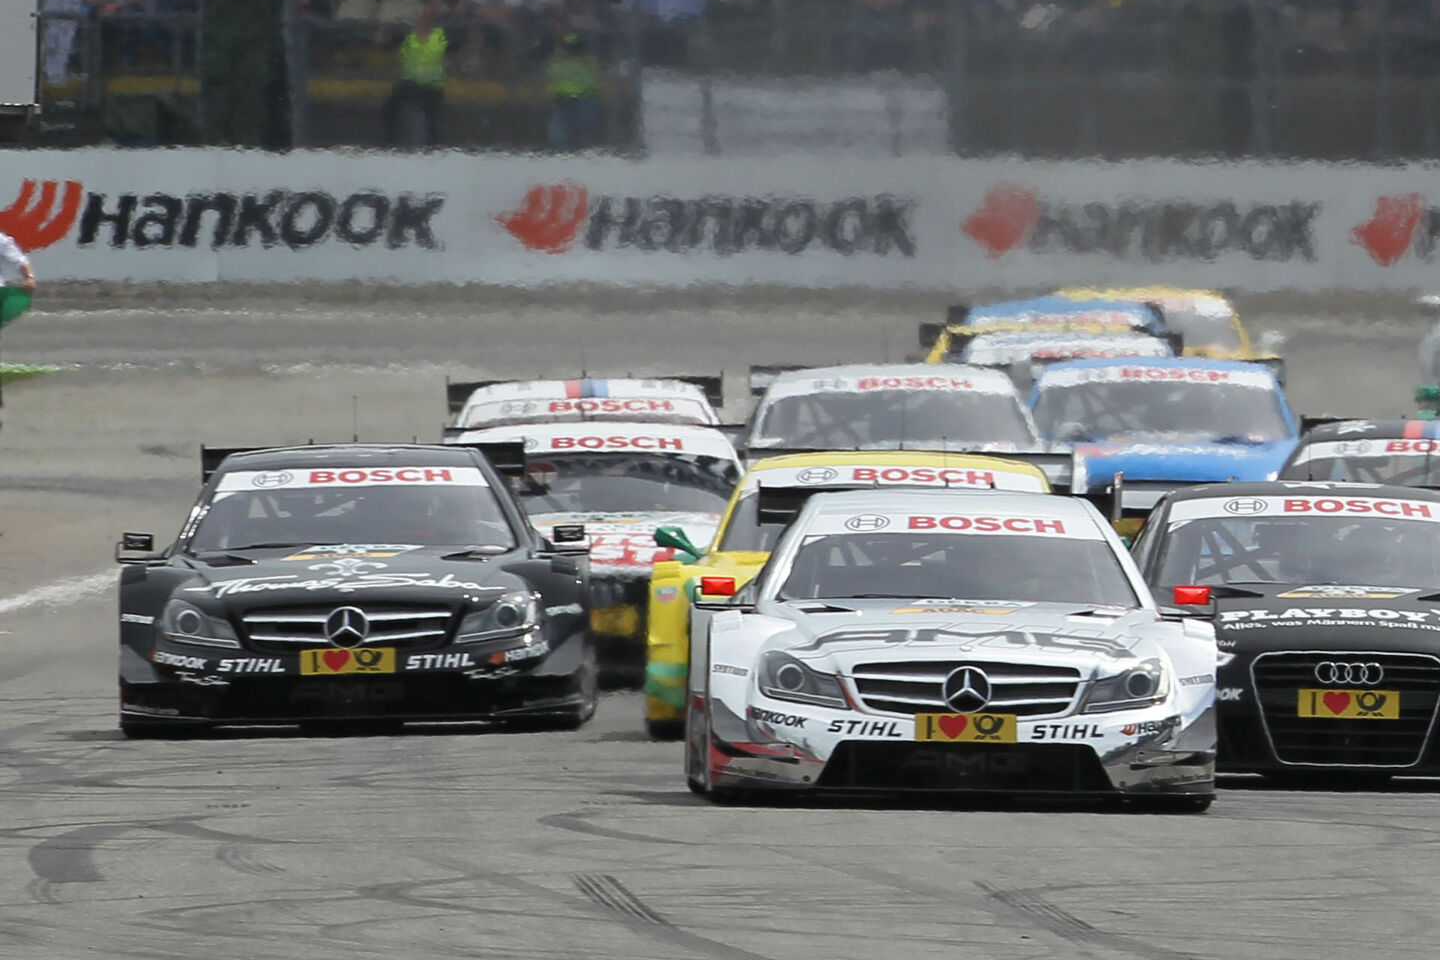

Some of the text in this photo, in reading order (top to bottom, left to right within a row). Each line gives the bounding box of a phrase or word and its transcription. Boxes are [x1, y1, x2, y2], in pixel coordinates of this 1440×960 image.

[1120, 367, 1230, 382] BOSCH
[858, 376, 972, 391] BOSCH
[549, 398, 673, 414] BOSCH
[552, 436, 683, 451] BOSCH
[310, 469, 452, 484] BOSCH
[853, 467, 994, 486] BOSCH
[1284, 497, 1432, 518] BOSCH
[908, 515, 1065, 535] BOSCH
[1220, 608, 1430, 622] PLAYBOY
[1223, 622, 1266, 631] Alles,
[217, 658, 286, 673] STIHL
[405, 652, 476, 670] STIHL
[828, 719, 904, 738] STIHL
[1031, 724, 1105, 740] STIHL
